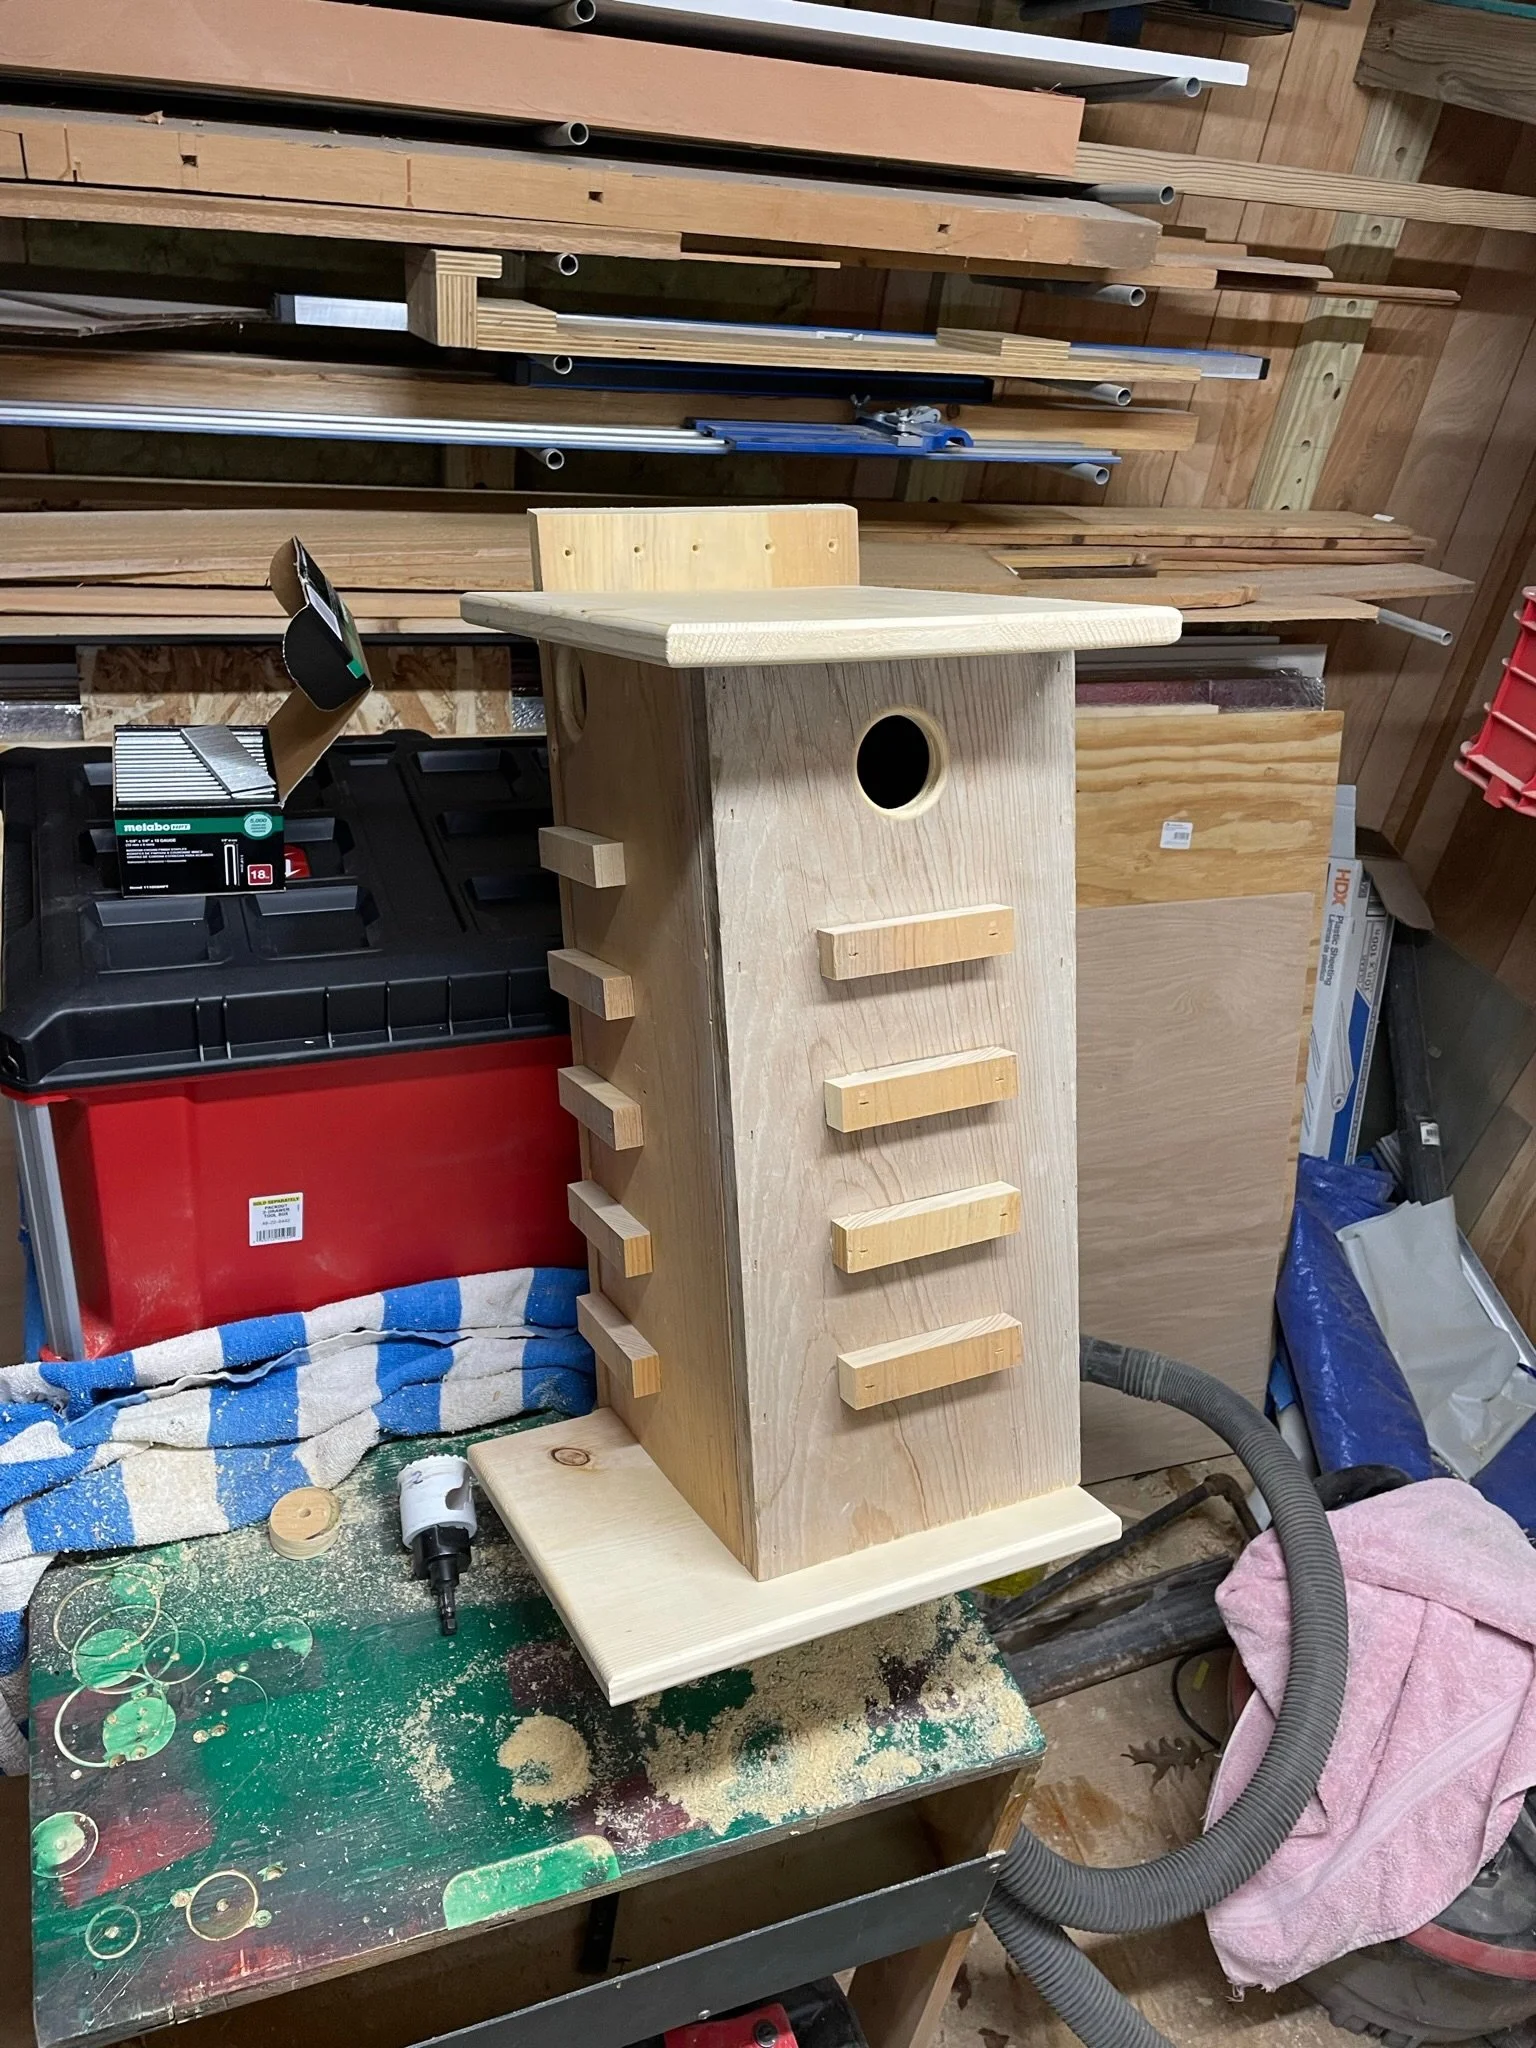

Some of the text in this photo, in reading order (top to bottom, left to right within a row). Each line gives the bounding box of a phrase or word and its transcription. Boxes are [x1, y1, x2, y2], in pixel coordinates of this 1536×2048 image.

[124, 822, 170, 832] metabo
[250, 870, 265, 879] 18
[1331, 868, 1351, 910] HDX
[1324, 915, 1344, 986] Plastic Sheeting
